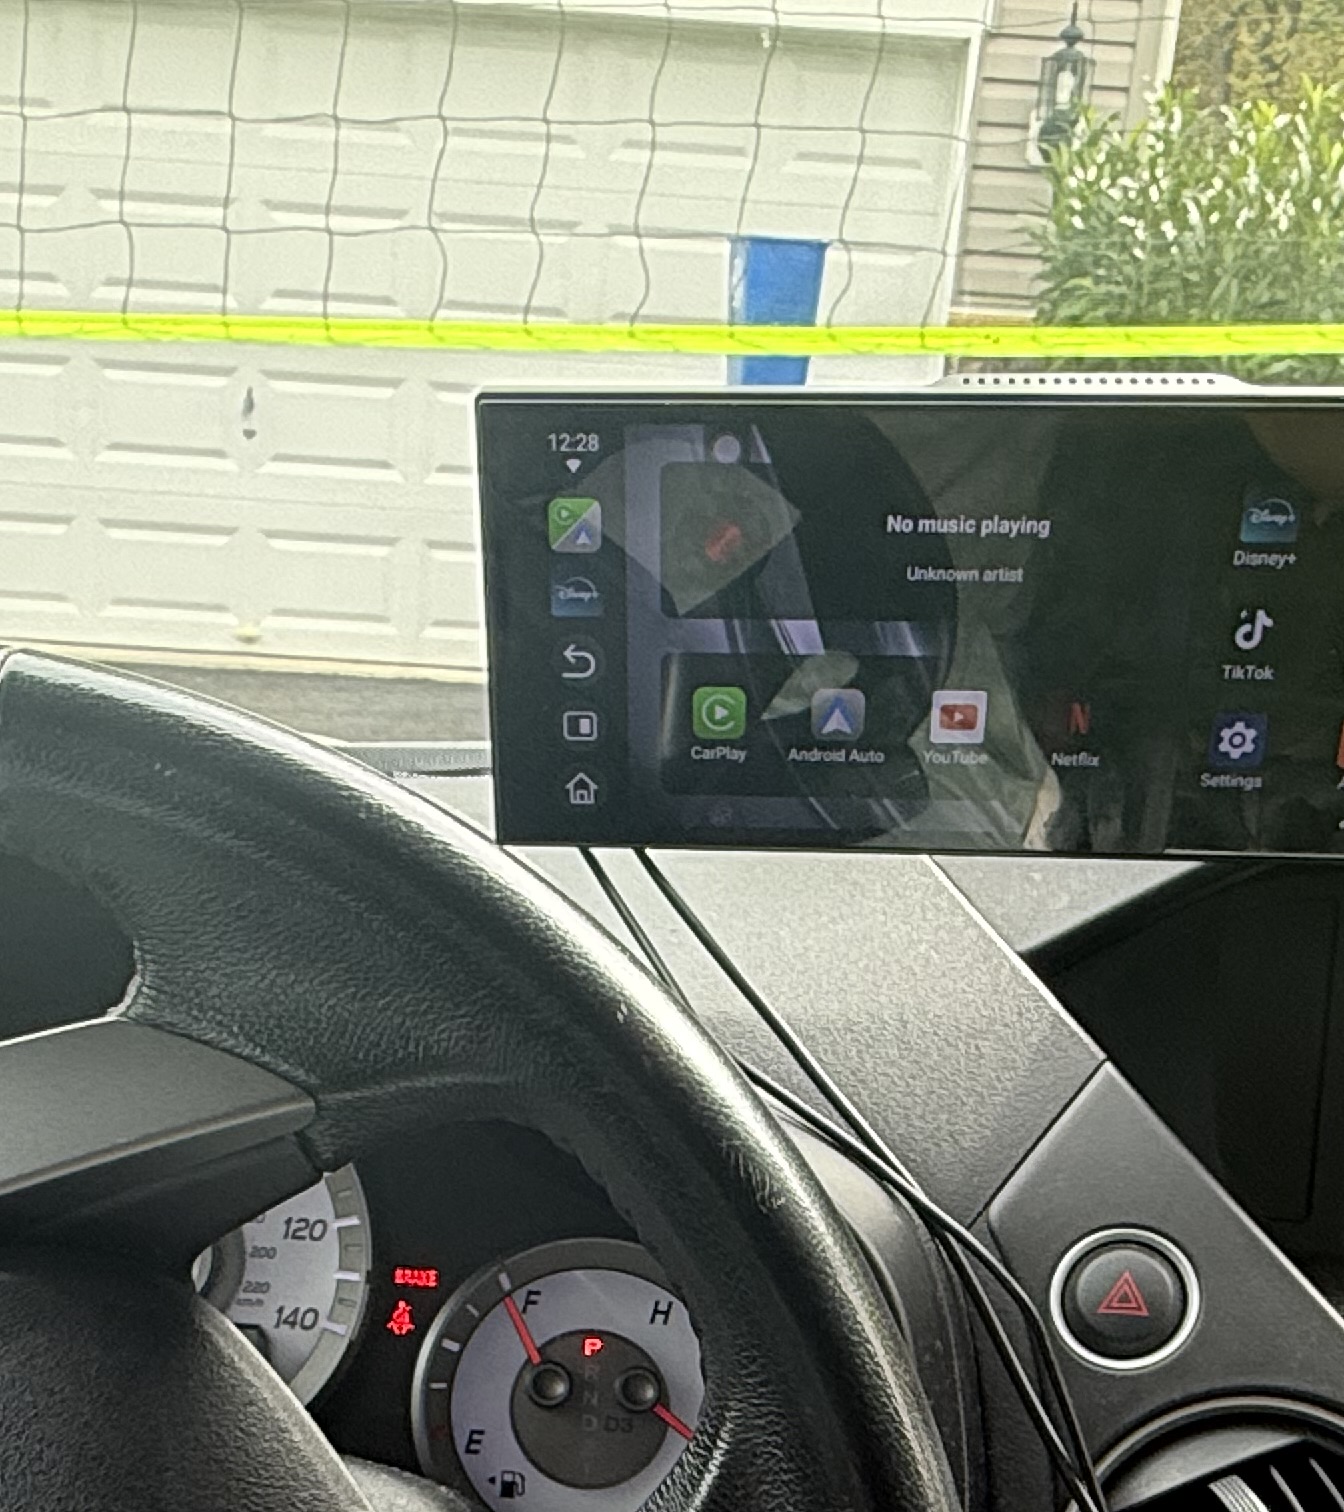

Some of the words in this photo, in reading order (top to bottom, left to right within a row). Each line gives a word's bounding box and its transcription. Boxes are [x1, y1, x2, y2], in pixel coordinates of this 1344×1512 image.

[548, 433, 599, 452] 12:28
[886, 515, 914, 534] No
[918, 516, 976, 534] music
[980, 516, 1050, 539] playing
[1232, 549, 1297, 568] Disney+
[906, 565, 979, 582] Unknown
[982, 566, 1023, 582] artist
[1221, 664, 1275, 681] TikTok
[690, 746, 747, 764] CarPlay
[788, 747, 845, 763] Android
[848, 748, 885, 764] Auto
[923, 749, 988, 765] YouTube
[1051, 751, 1100, 767] Netflix
[1199, 772, 1263, 790] Settings
[283, 1216, 328, 1242] 120
[249, 1246, 278, 1260] 200
[394, 1266, 439, 1288] BRAKE
[242, 1281, 271, 1294] 220
[522, 1290, 542, 1314] F
[274, 1305, 319, 1330] 140
[649, 1300, 674, 1326] H
[583, 1336, 604, 1357] P
[464, 1429, 485, 1454] E
